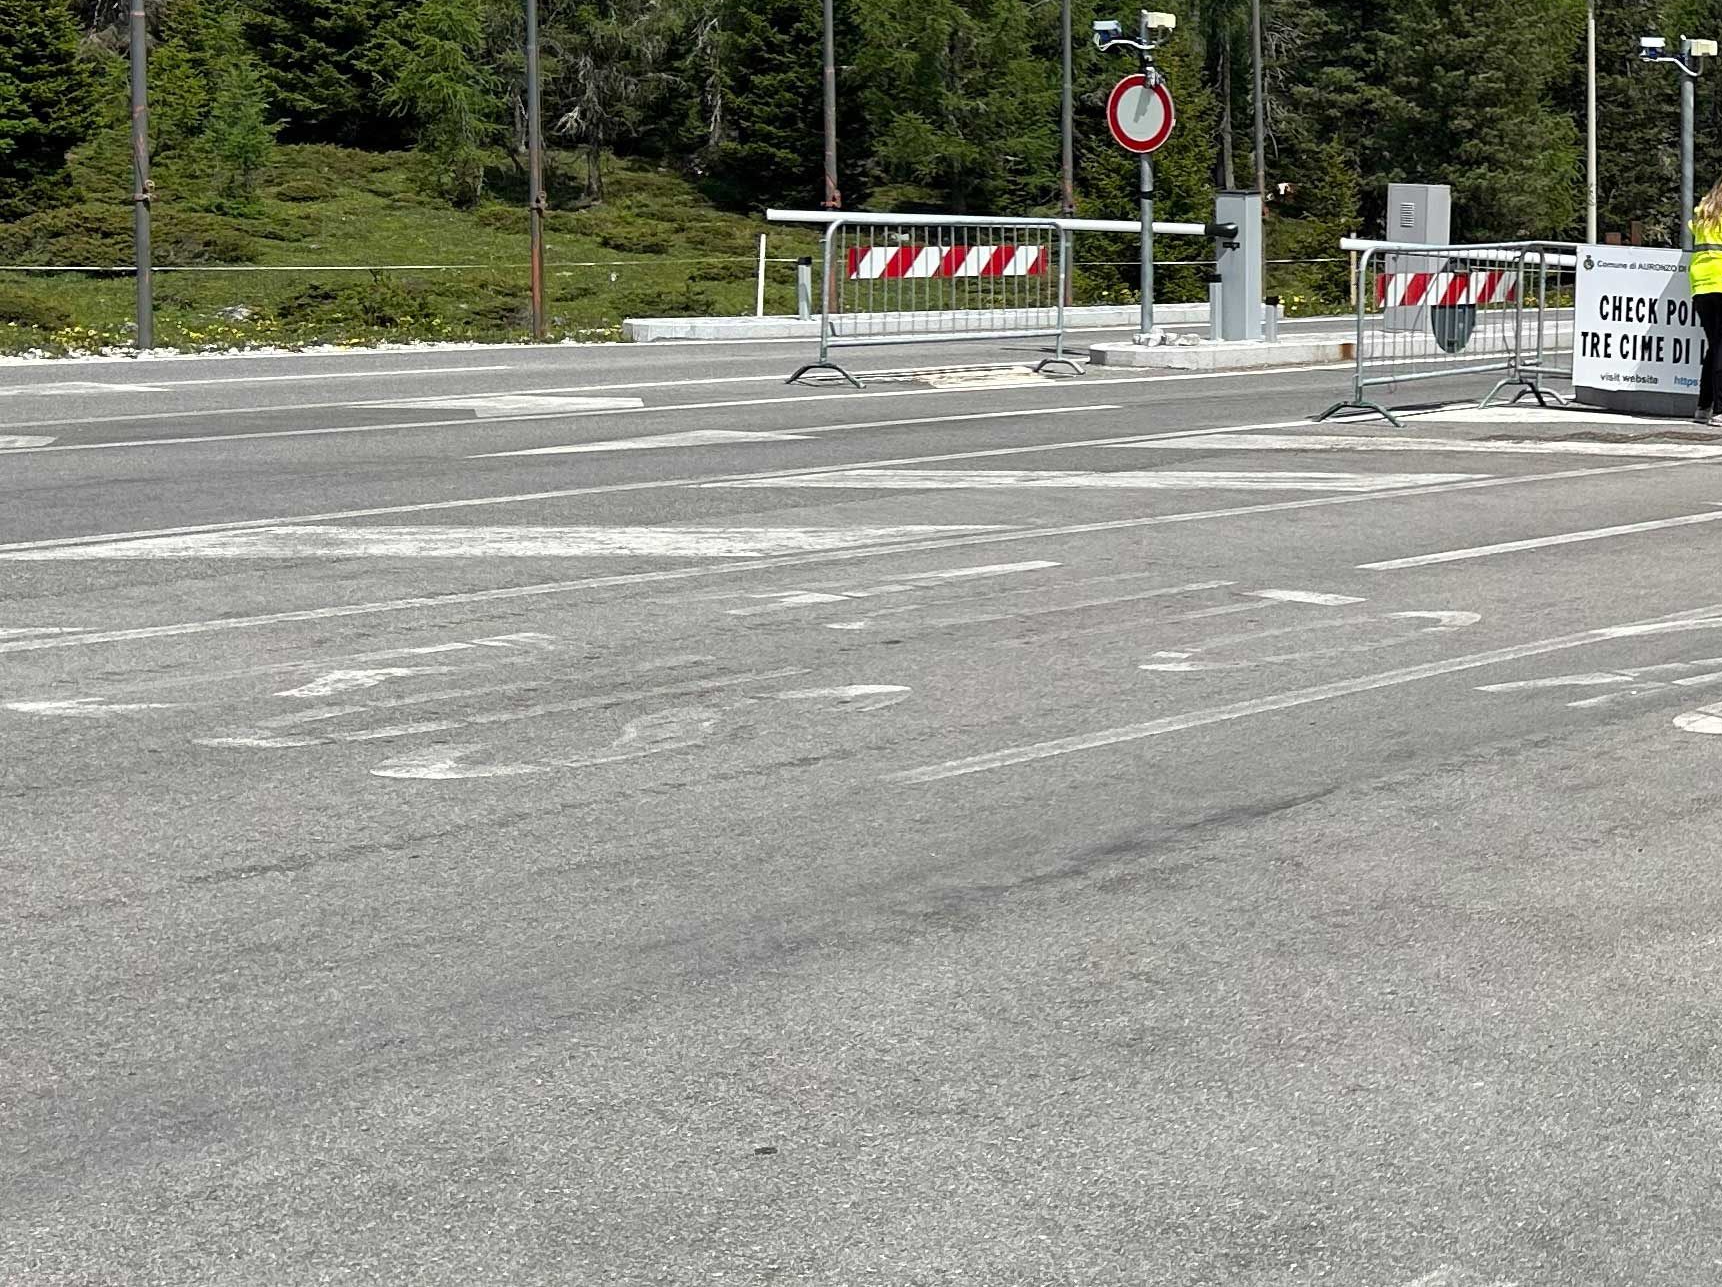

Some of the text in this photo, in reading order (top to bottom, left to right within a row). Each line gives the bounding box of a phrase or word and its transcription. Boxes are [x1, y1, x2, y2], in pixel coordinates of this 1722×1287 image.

[1597, 260, 1628, 269] Comune
[1629, 262, 1637, 270] di
[1600, 295, 1658, 324] CHECK
[1666, 299, 1696, 327] POI
[1581, 331, 1611, 358] TRE
[1620, 334, 1664, 362] CIME
[1672, 338, 1690, 365] DI
[1600, 373, 1621, 381] visit
[1622, 374, 1658, 384] website
